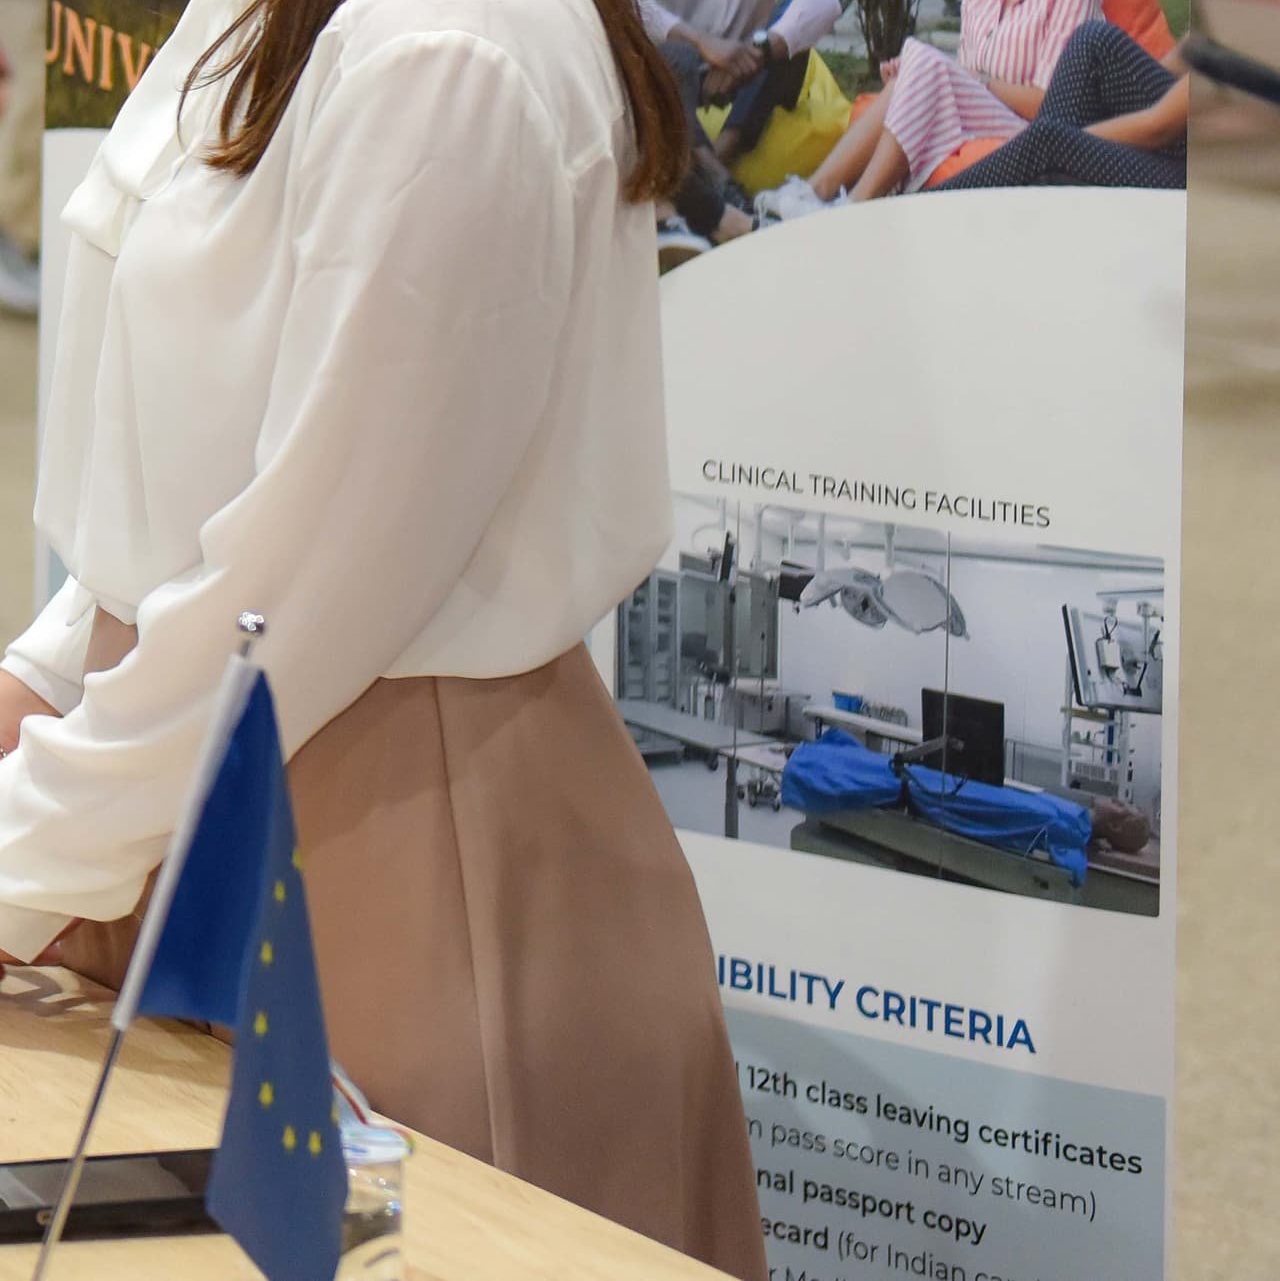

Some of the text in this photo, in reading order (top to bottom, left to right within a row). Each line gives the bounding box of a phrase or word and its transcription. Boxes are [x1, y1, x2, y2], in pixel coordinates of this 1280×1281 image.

[702, 458, 1051, 528] CLINICAL TRAINING FACILITIES
[856, 985, 1037, 1055] CRITERIA
[746, 1065, 1143, 1175] 12th class leaving certificates
[771, 1122, 827, 1154] pass
[833, 1137, 900, 1171] score
[907, 1150, 929, 1179] in
[937, 1163, 985, 1196] any
[991, 1175, 1096, 1223] stream)
[802, 1179, 916, 1224] passport
[923, 1209, 987, 1246] copy
[838, 1229, 880, 1264] (for
[887, 1243, 966, 1281] Indian
